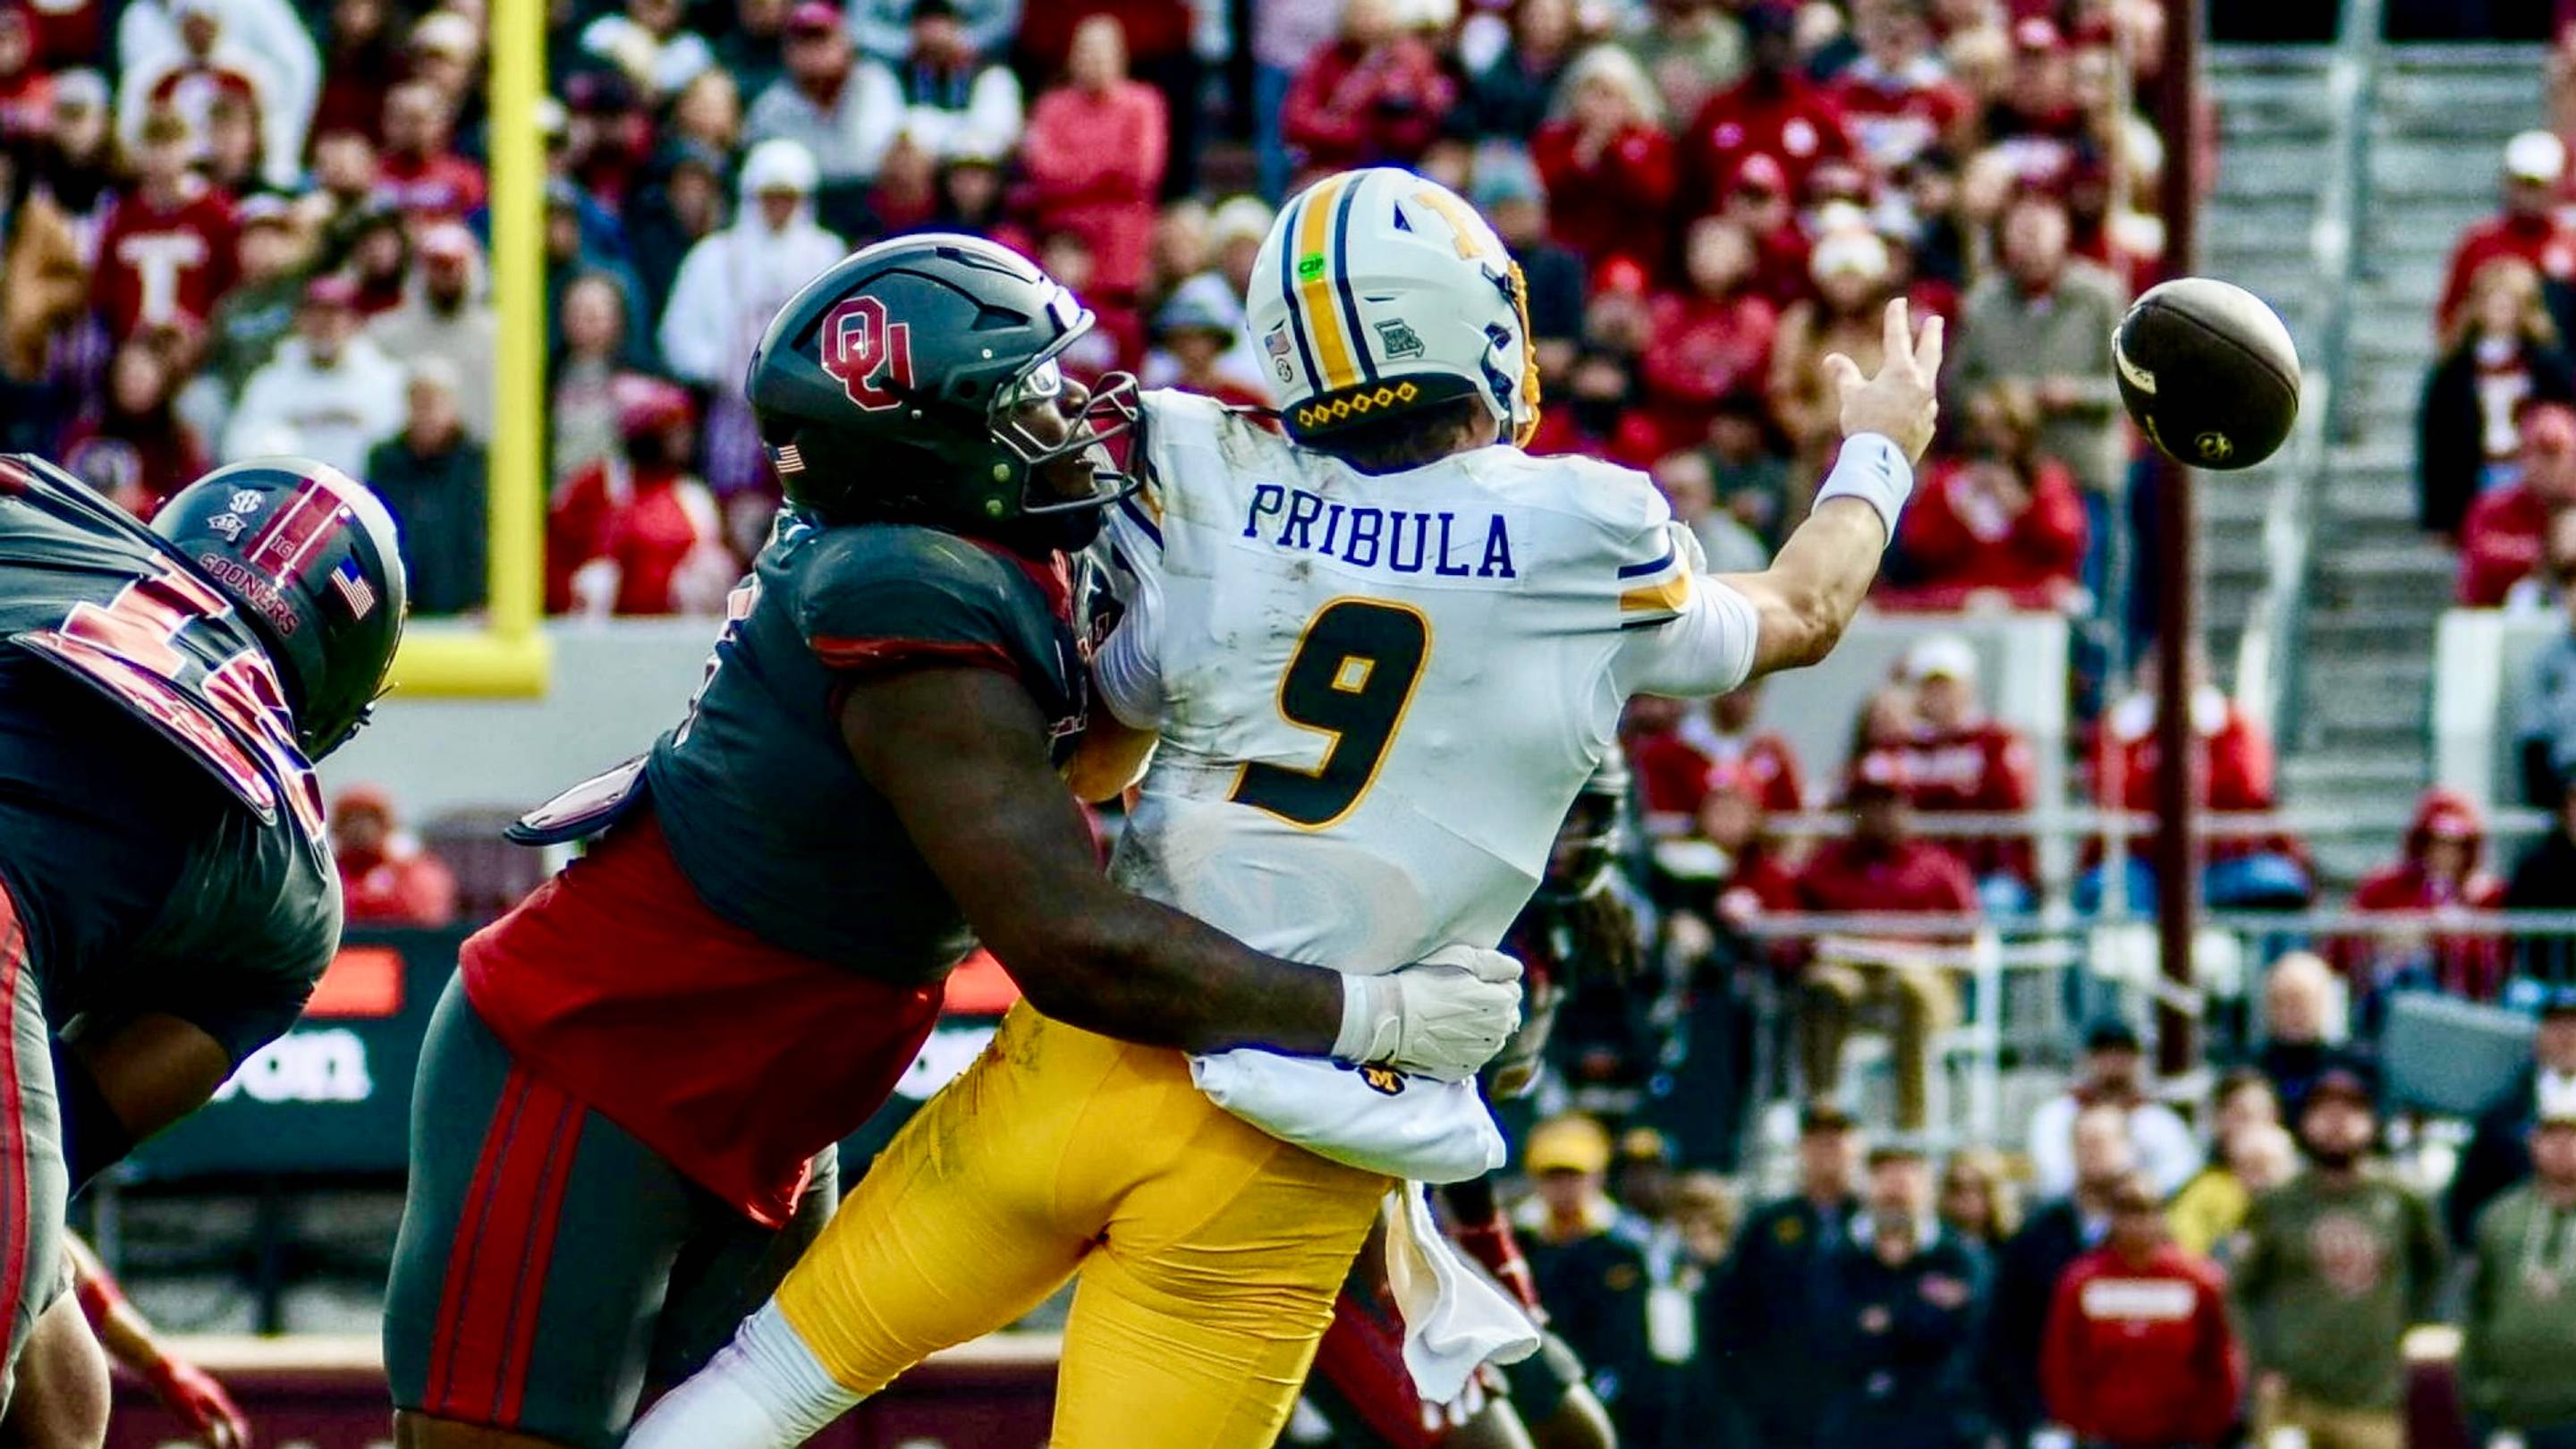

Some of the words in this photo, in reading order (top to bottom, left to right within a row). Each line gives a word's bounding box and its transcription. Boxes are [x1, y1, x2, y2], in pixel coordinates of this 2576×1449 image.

[820, 295, 915, 411] OU
[229, 489, 265, 514] SEC
[1241, 483, 1517, 579] PRIBULA
[199, 552, 300, 637] SOONERS
[1225, 595, 1435, 832] 9
[213, 1029, 372, 1102] on
[1364, 1067, 1397, 1092] M
